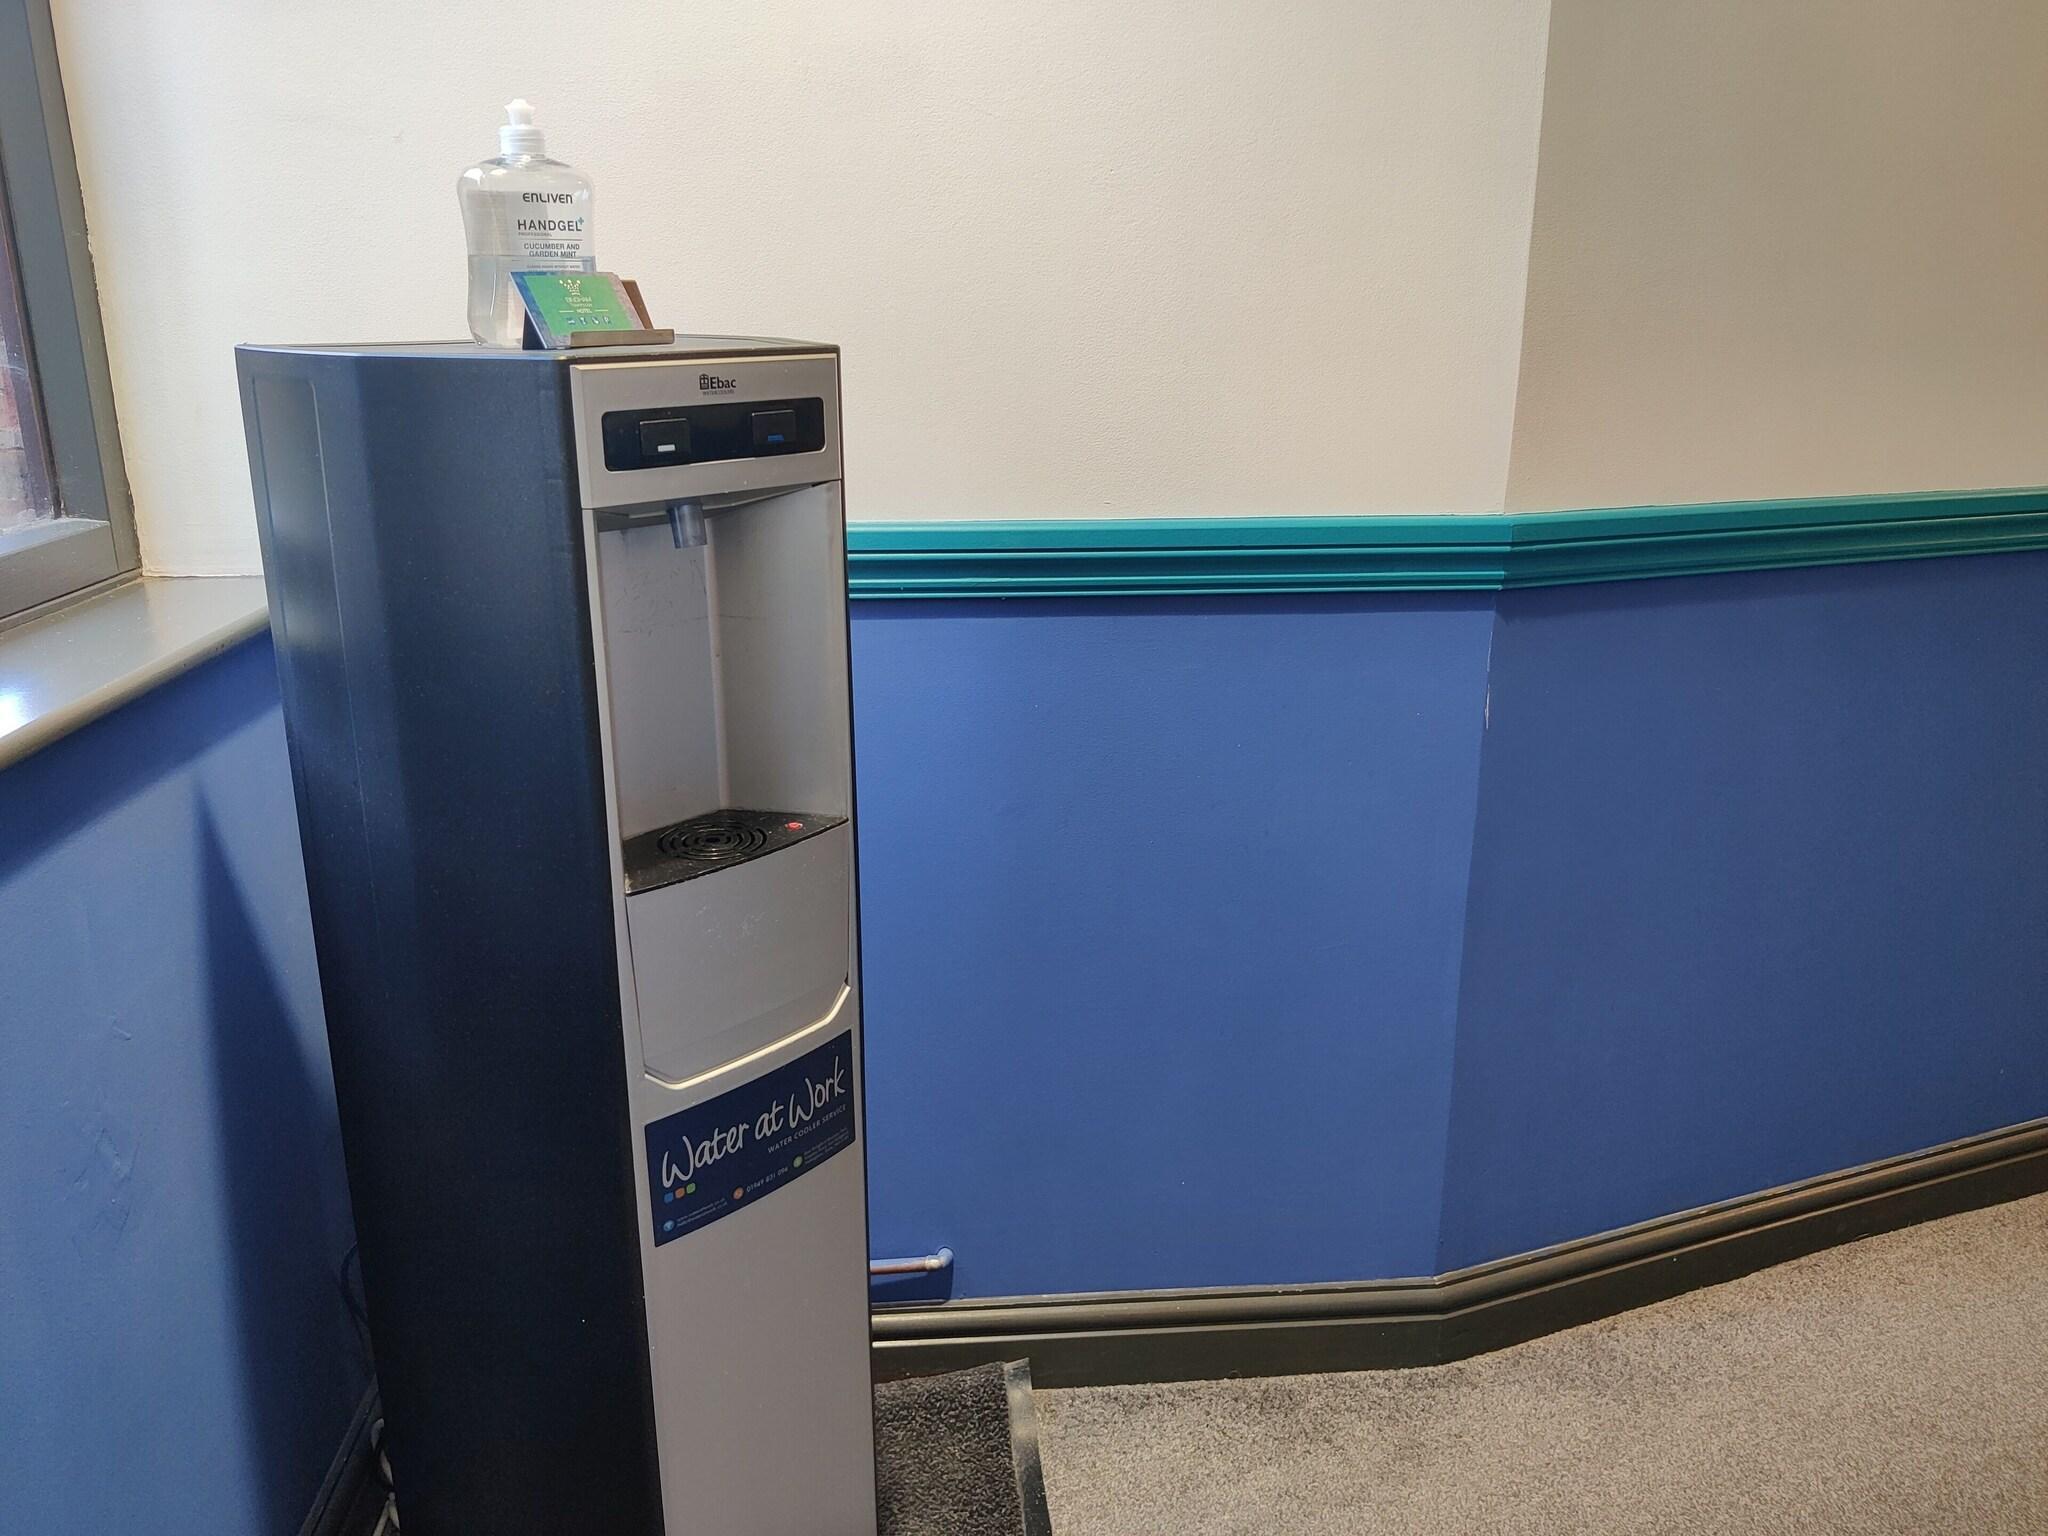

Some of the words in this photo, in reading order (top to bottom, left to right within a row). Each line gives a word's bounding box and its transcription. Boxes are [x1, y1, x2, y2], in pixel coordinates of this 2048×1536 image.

[522, 192, 573, 204] ENLIVEN
[517, 218, 582, 232] HANDGEL
[710, 376, 737, 389] Ebac
[661, 1122, 750, 1189] Water
[754, 1100, 784, 1140] at
[789, 1056, 846, 1129] Work
[768, 1136, 793, 1153] WATER
[794, 1119, 822, 1139] COOLER
[822, 1104, 847, 1122] SERVICE
